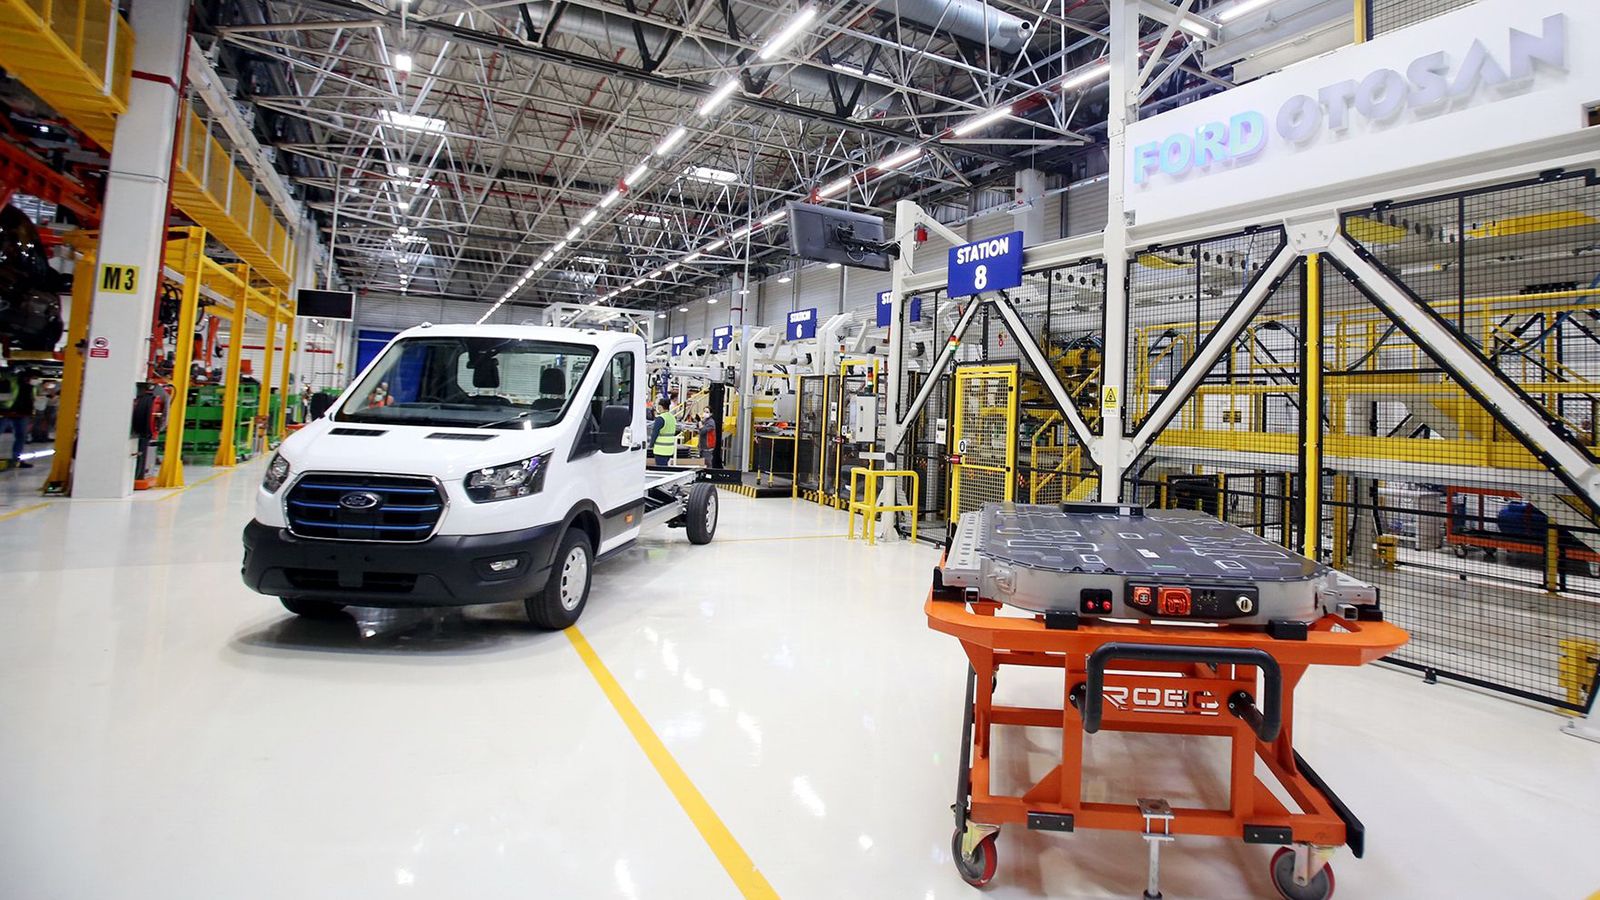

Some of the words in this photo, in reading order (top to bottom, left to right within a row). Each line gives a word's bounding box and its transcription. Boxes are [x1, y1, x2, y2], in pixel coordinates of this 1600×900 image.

[1133, 110, 1267, 185] FORD
[1276, 12, 1567, 143] OTOSAN
[956, 237, 1009, 265] STATION
[974, 264, 988, 290] 8
[796, 323, 803, 339] 6
